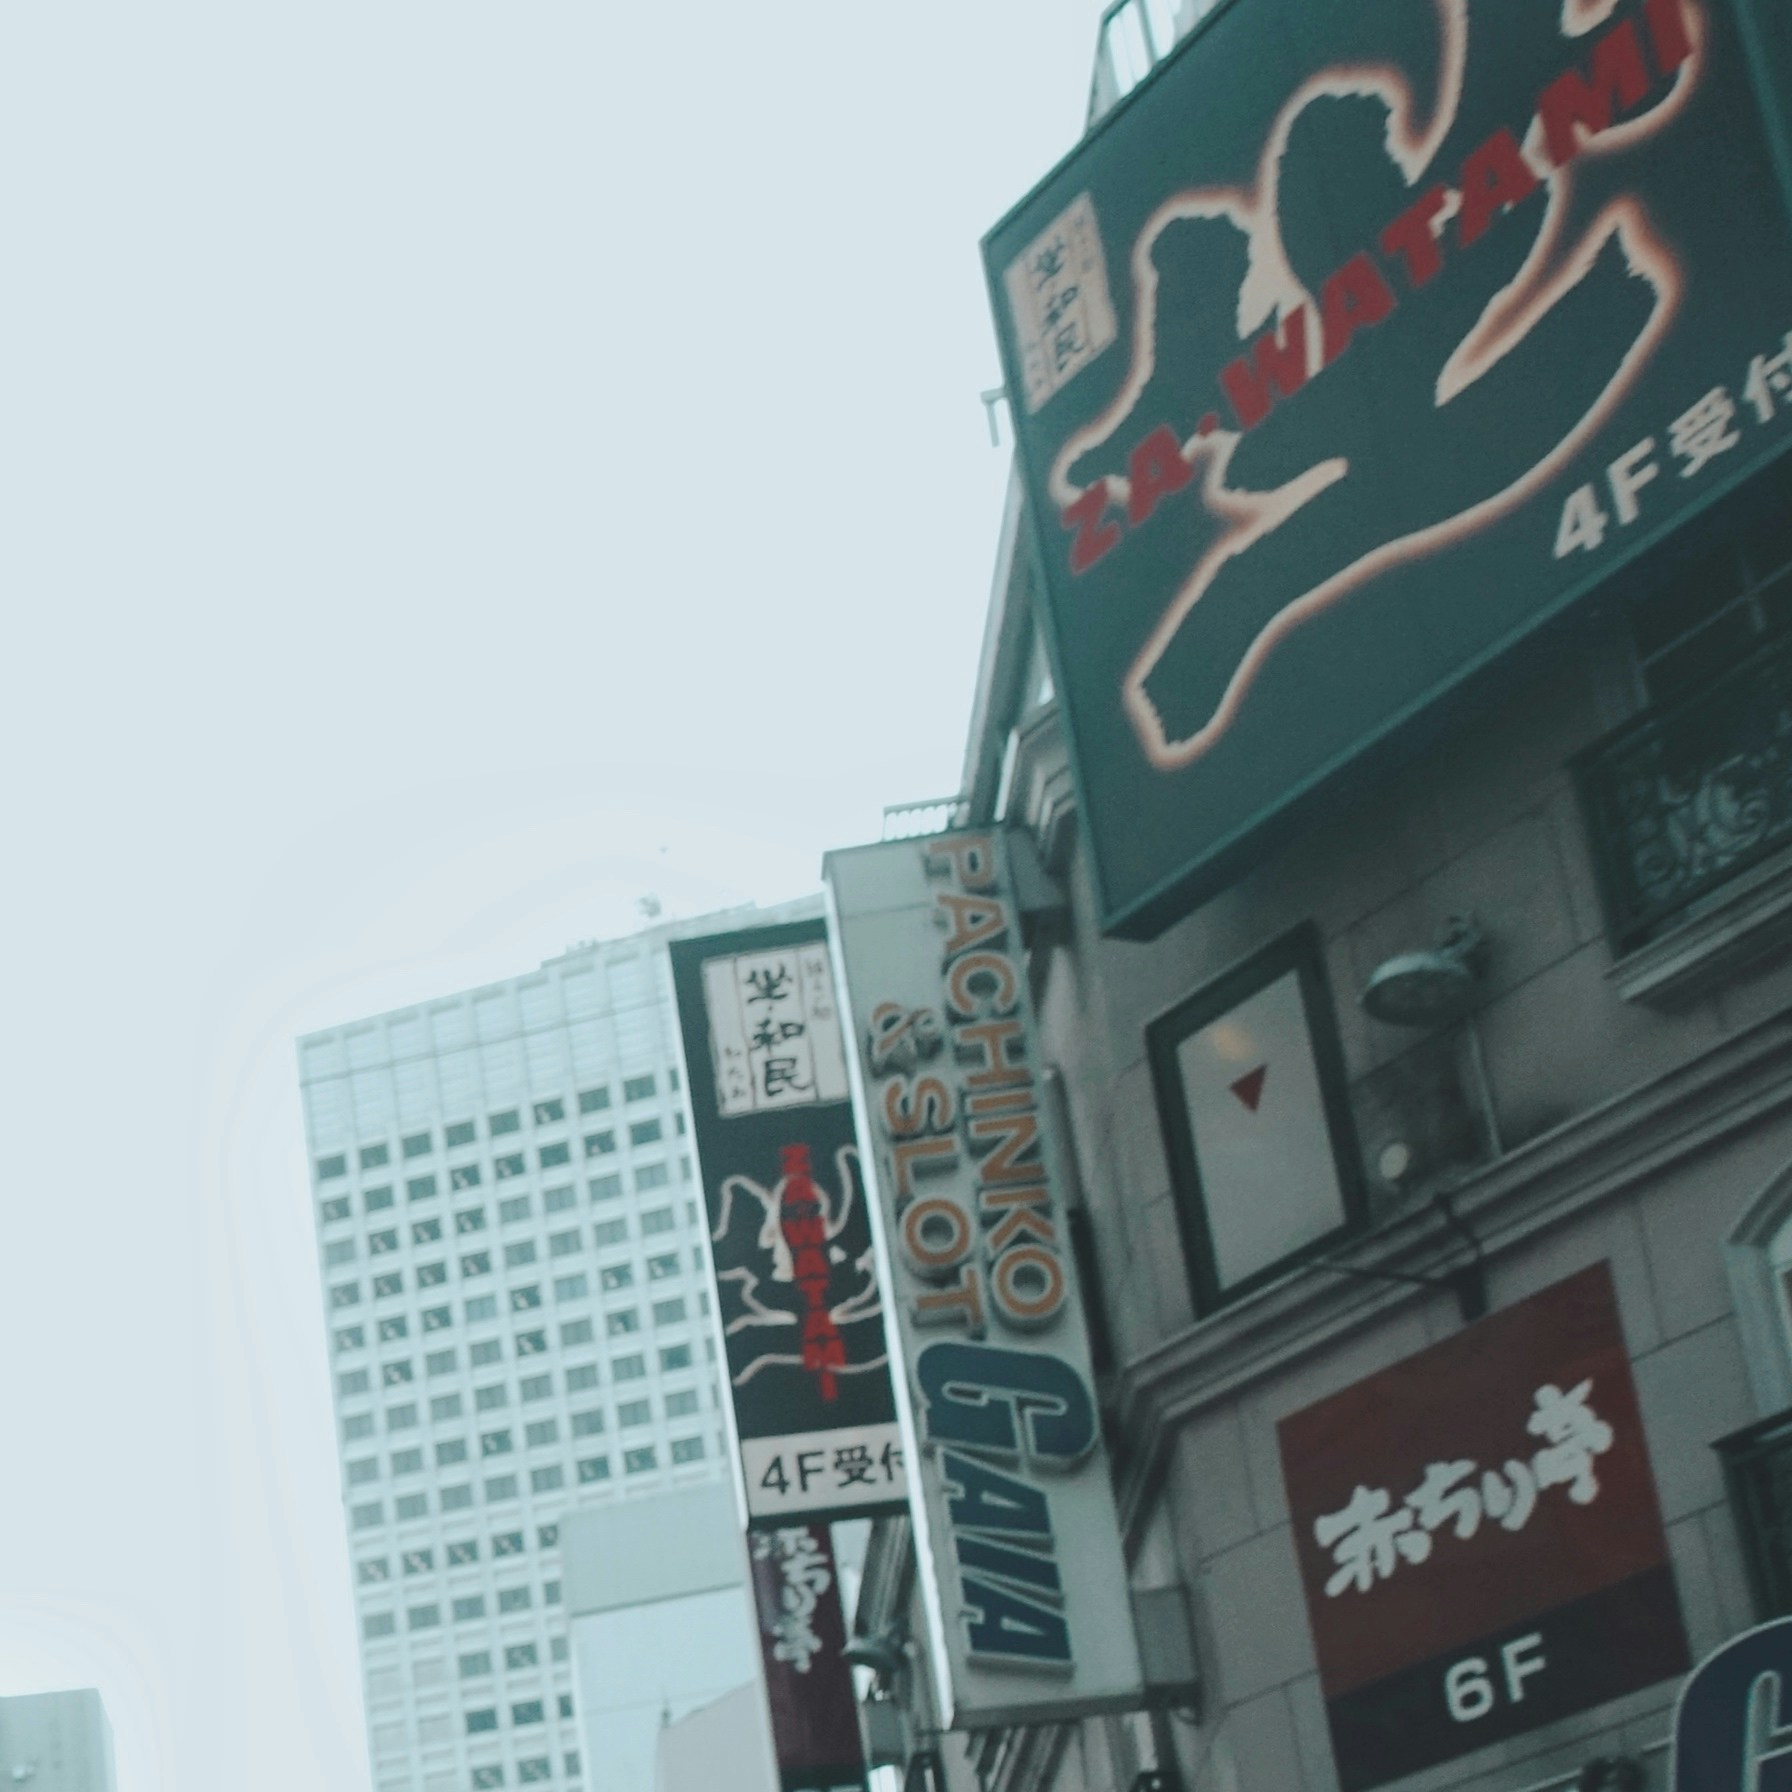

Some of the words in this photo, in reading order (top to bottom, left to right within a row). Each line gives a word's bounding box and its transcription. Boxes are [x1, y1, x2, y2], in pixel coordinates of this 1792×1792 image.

[883, 1074, 984, 1342] SLOT
[929, 834, 1066, 1321] PACHINKO
[1443, 1632, 1548, 1723] 6F
